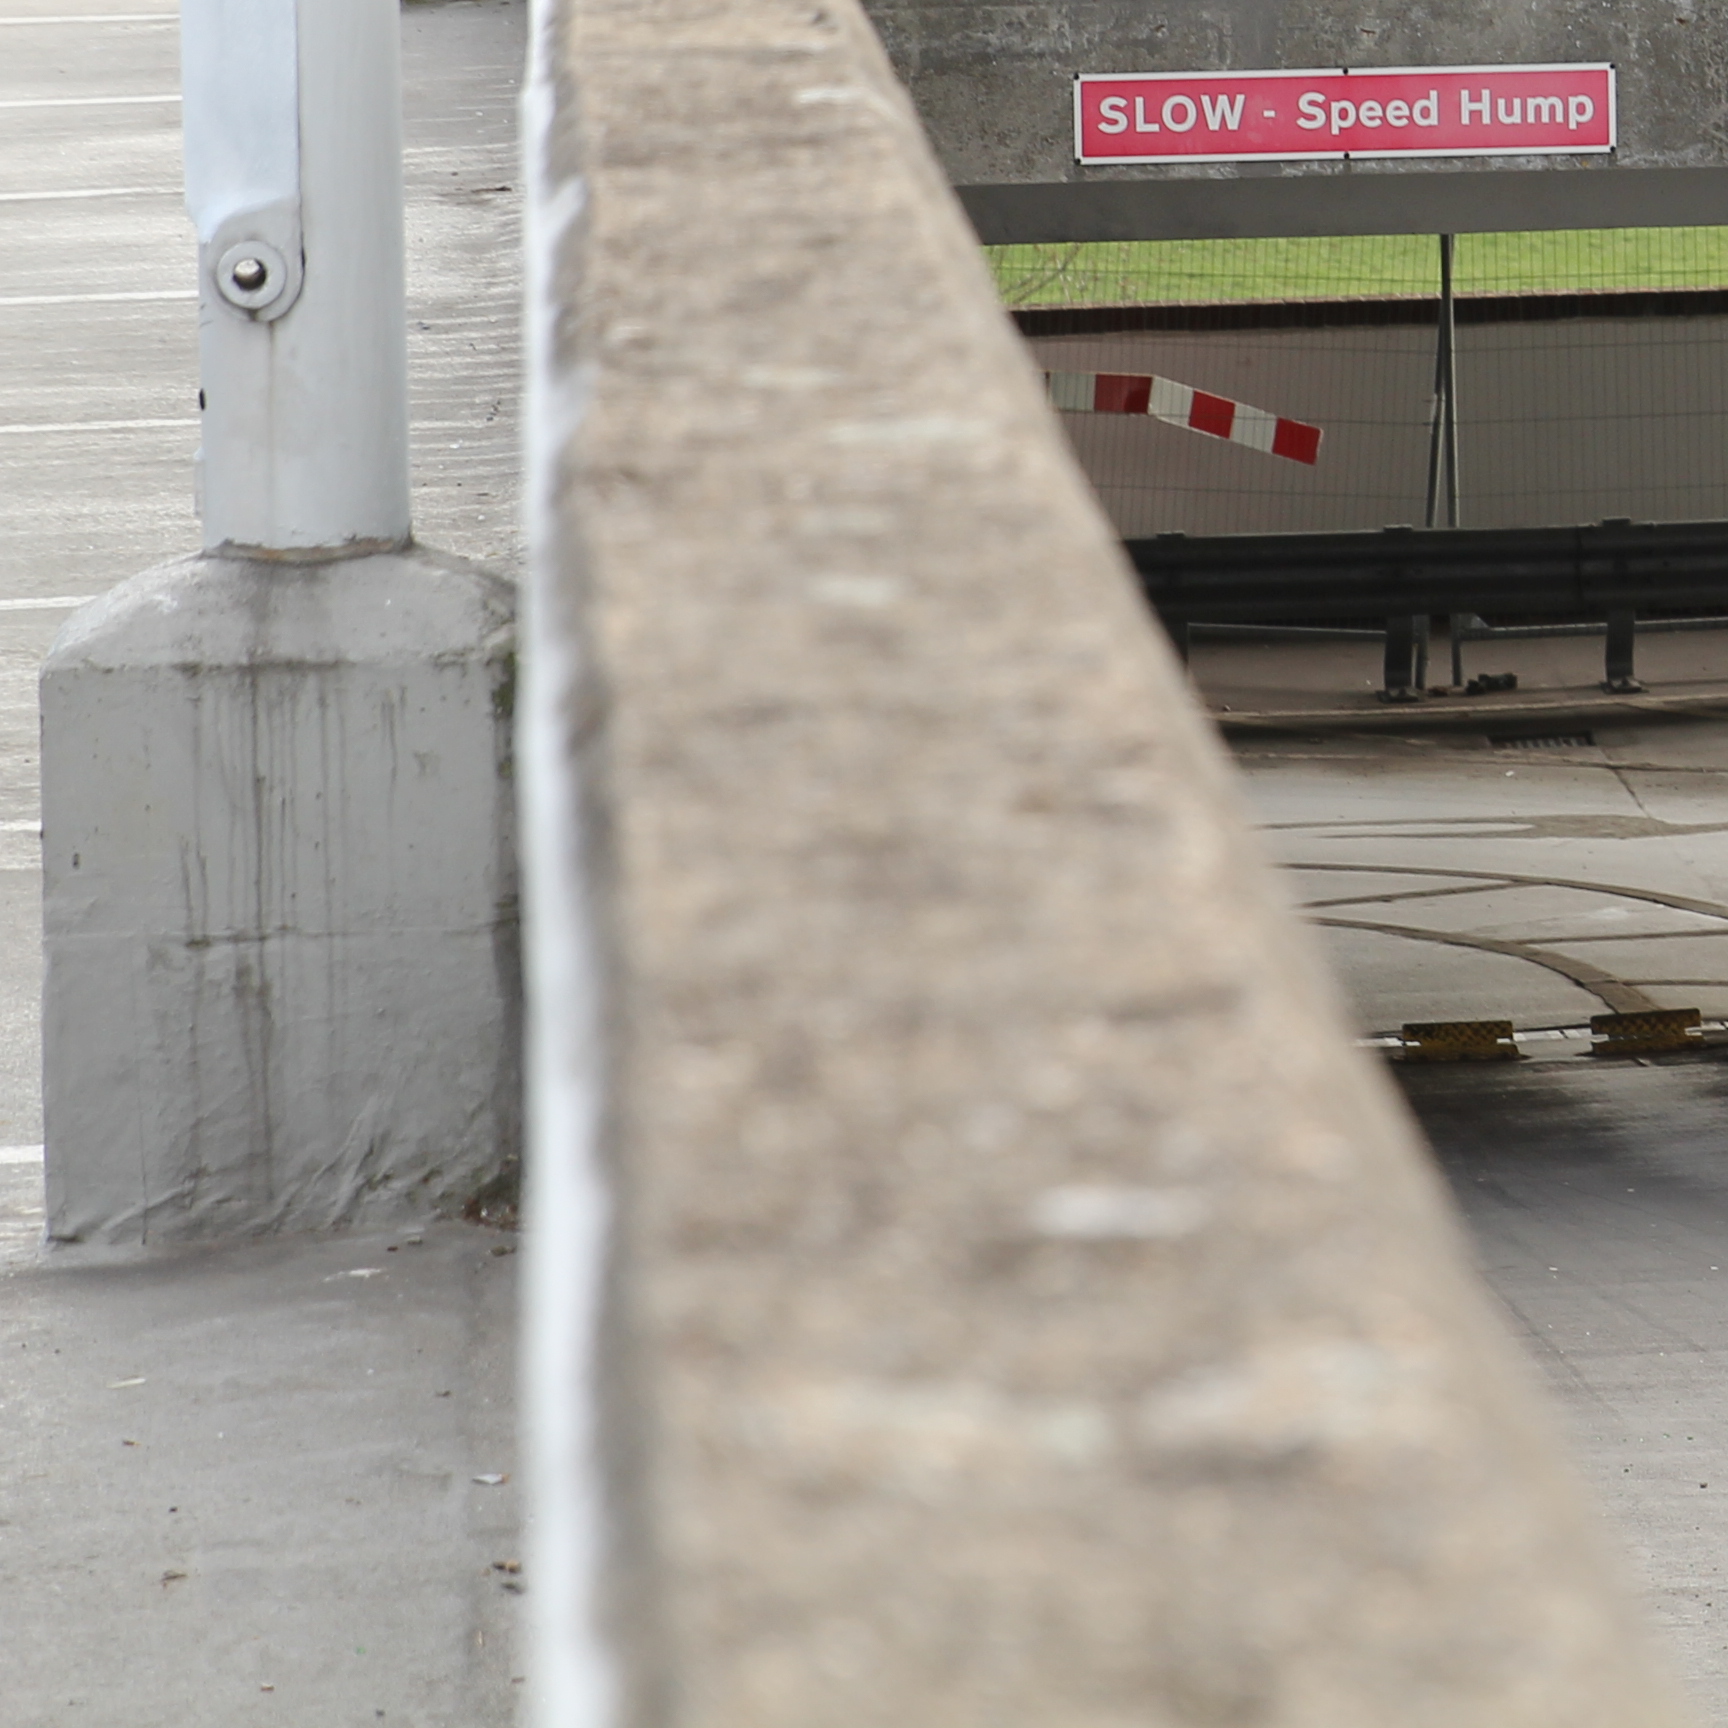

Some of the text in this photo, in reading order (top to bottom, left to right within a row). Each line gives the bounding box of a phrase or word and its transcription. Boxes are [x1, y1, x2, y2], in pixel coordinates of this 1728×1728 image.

[1098, 93, 1245, 135] SLOW
[1296, 90, 1439, 135] Speed
[1460, 88, 1595, 131] Hump
